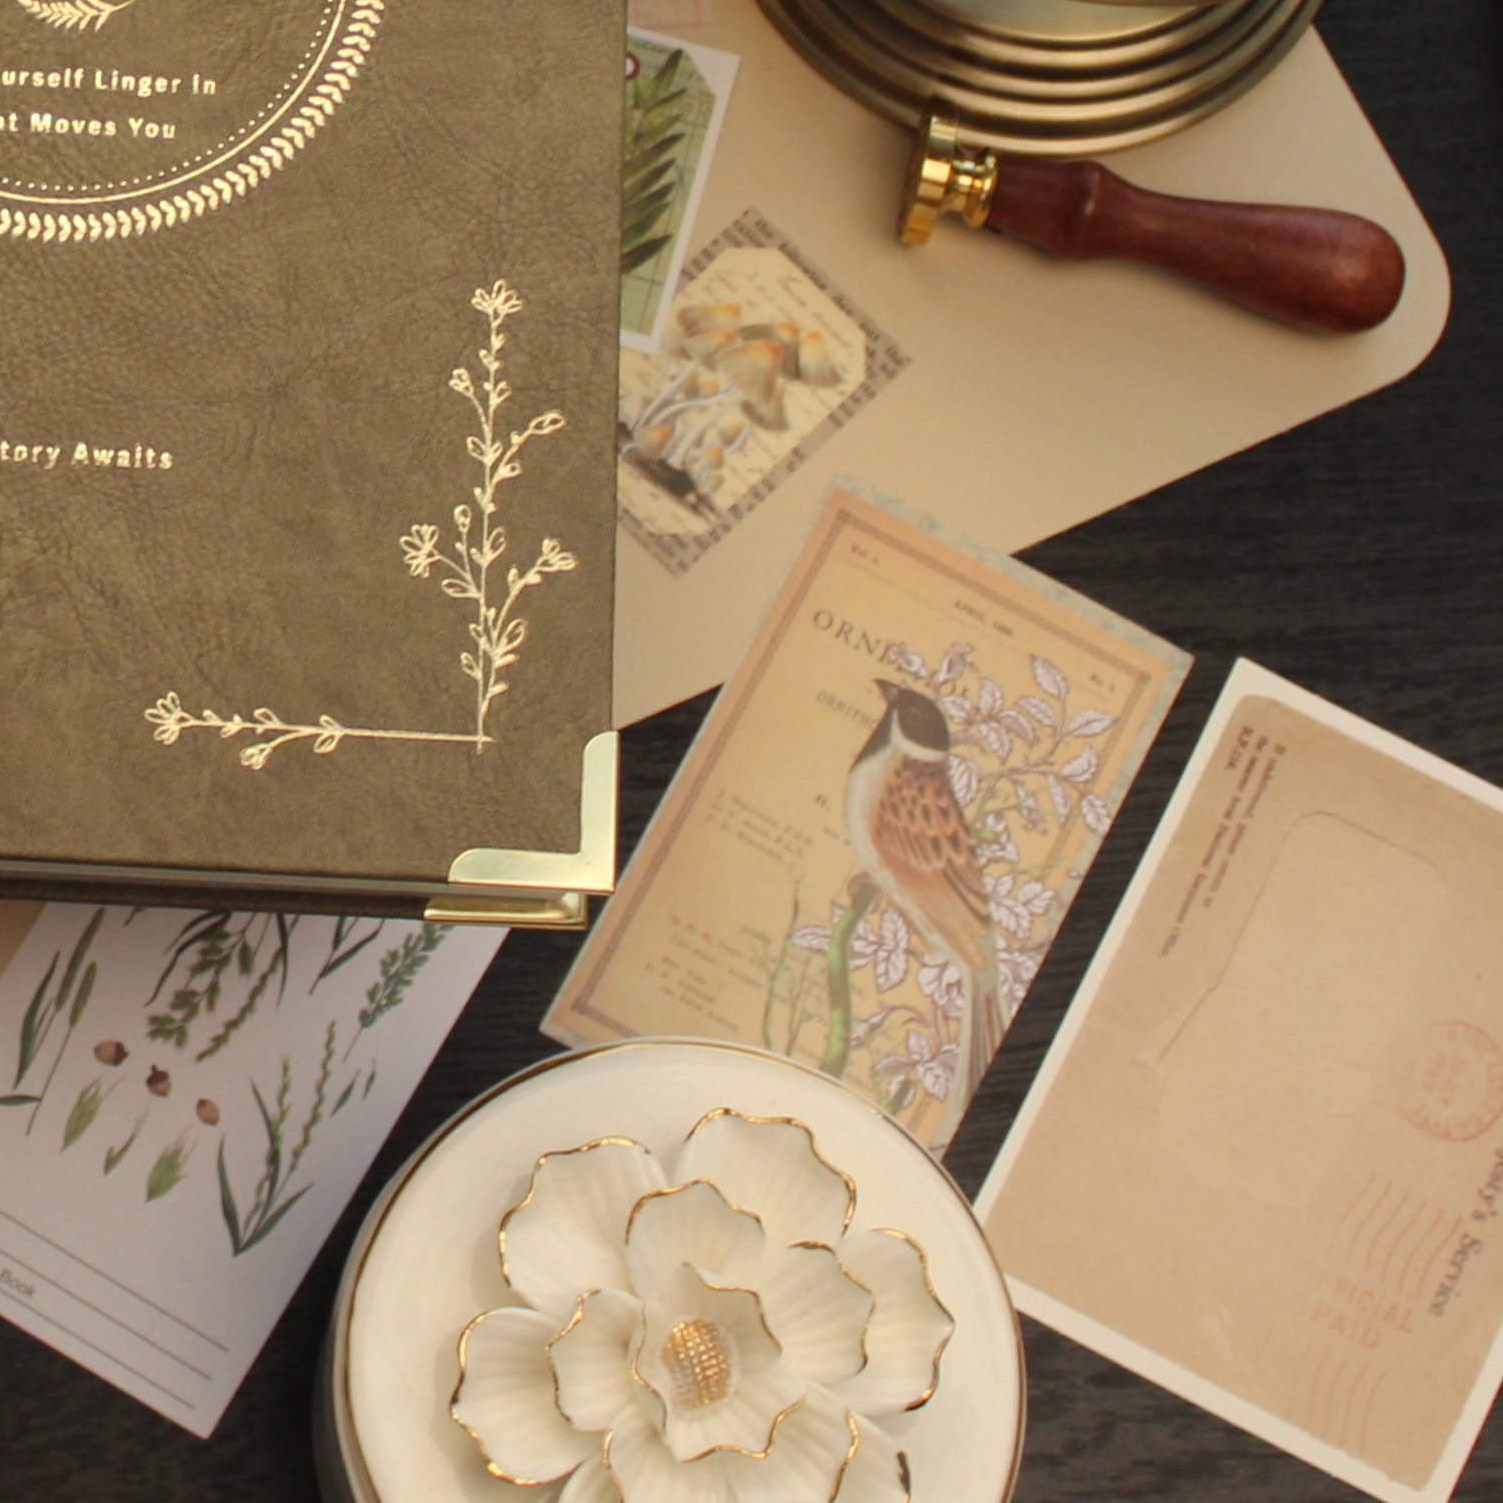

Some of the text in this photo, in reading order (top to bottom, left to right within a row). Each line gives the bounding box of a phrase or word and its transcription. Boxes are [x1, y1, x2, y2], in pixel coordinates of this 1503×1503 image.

[94, 69, 182, 98] Linger
[30, 112, 117, 137] Moves
[128, 117, 176, 139] You
[71, 441, 174, 470] Awaits
[1430, 1148, 1503, 1317] esty's Service
[0, 1268, 36, 1299] Book
